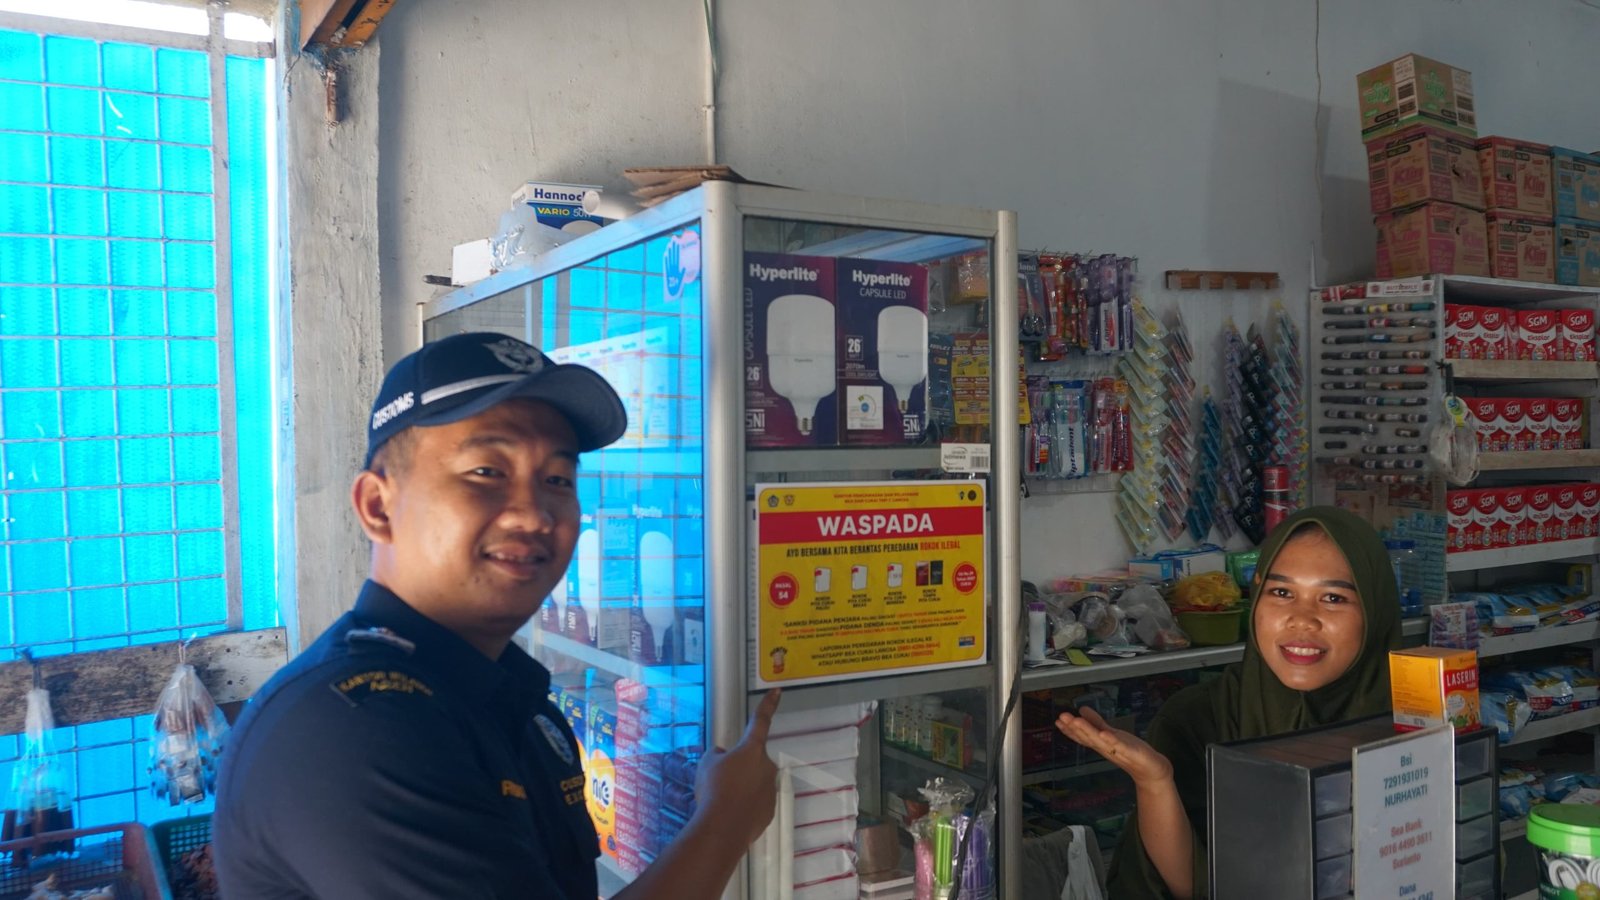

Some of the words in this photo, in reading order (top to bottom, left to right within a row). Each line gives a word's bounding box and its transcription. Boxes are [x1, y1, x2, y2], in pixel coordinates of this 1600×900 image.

[534, 188, 586, 202] Hannoc
[537, 208, 570, 216] VARIO
[750, 264, 818, 282] Hyperlite
[852, 270, 911, 287] Hyperlite
[860, 288, 892, 298] CAPSULE
[893, 289, 907, 299] LED
[1458, 311, 1474, 323] SGM
[1484, 312, 1499, 324] SGM
[1528, 315, 1548, 327] SGM
[1570, 315, 1587, 326] SGM
[848, 338, 860, 352] 26
[747, 367, 760, 380] 26
[372, 392, 414, 430] CUSTOMS
[1480, 404, 1494, 415] SGM
[1506, 405, 1520, 416] SGM
[1532, 404, 1546, 415] SGM
[1557, 405, 1570, 415] SGM
[746, 413, 765, 428] SNI
[1480, 495, 1495, 508] SGM
[1507, 494, 1522, 506] SGM
[1534, 492, 1548, 504] SGM
[1560, 491, 1573, 503] SGM
[1584, 489, 1597, 501] SGM
[1453, 496, 1468, 509] SGM
[817, 513, 934, 536] WASPADA
[786, 548, 799, 557] AYO
[801, 548, 832, 557] BERSAMA
[834, 547, 848, 555] KITA
[850, 545, 881, 555] BERANTAS
[883, 542, 918, 553] PEREDARAN
[920, 542, 939, 552] ROKOK
[941, 540, 960, 550] ILEGAL
[1446, 669, 1475, 687] LASERIN
[1401, 752, 1412, 767] Bsi
[1384, 767, 1428, 789] 7291931019
[1385, 784, 1428, 807] NURHAYATI
[1391, 826, 1404, 837] Sea
[1405, 818, 1422, 833] Bank
[1400, 883, 1416, 896] Dana
